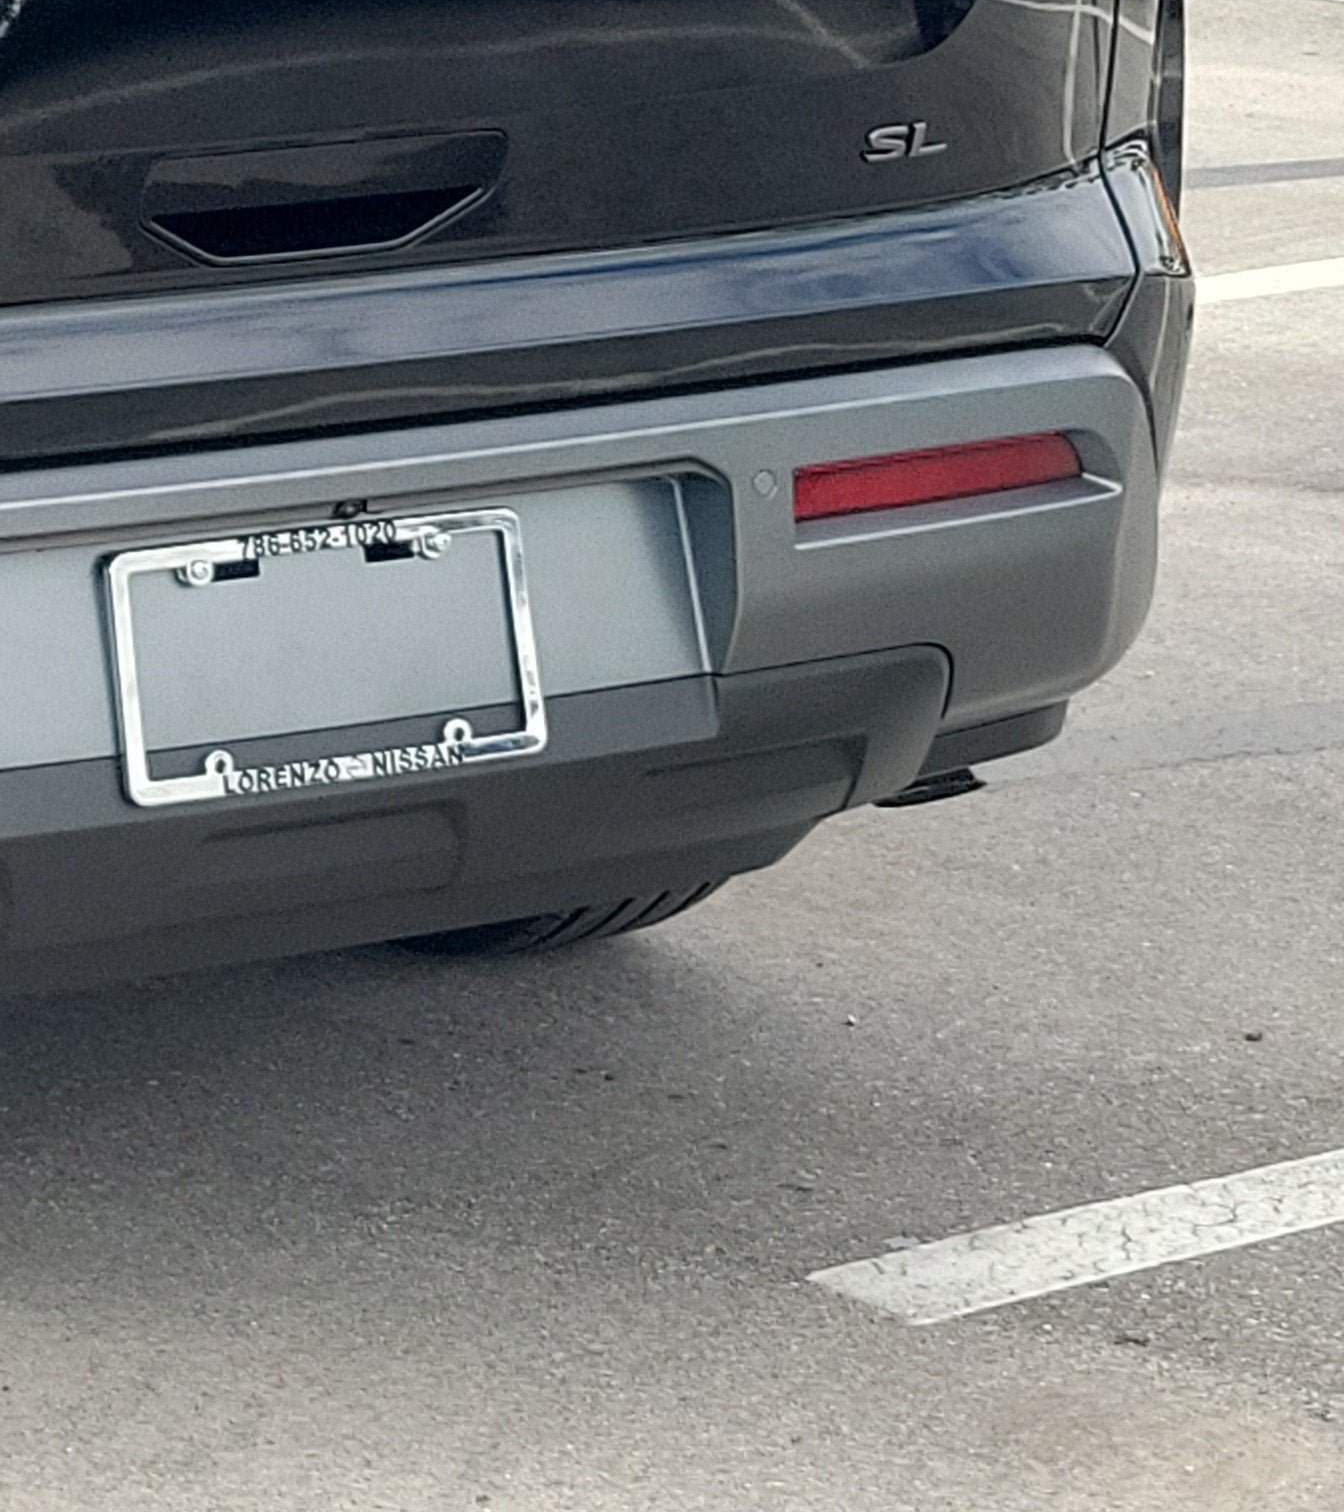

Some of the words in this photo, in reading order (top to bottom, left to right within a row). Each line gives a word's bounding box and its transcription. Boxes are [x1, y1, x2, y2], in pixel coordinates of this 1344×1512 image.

[862, 120, 948, 163] SL
[236, 520, 397, 561] 786-652-1020
[222, 757, 341, 795] LORENZO
[372, 742, 465, 776] NISSAN
